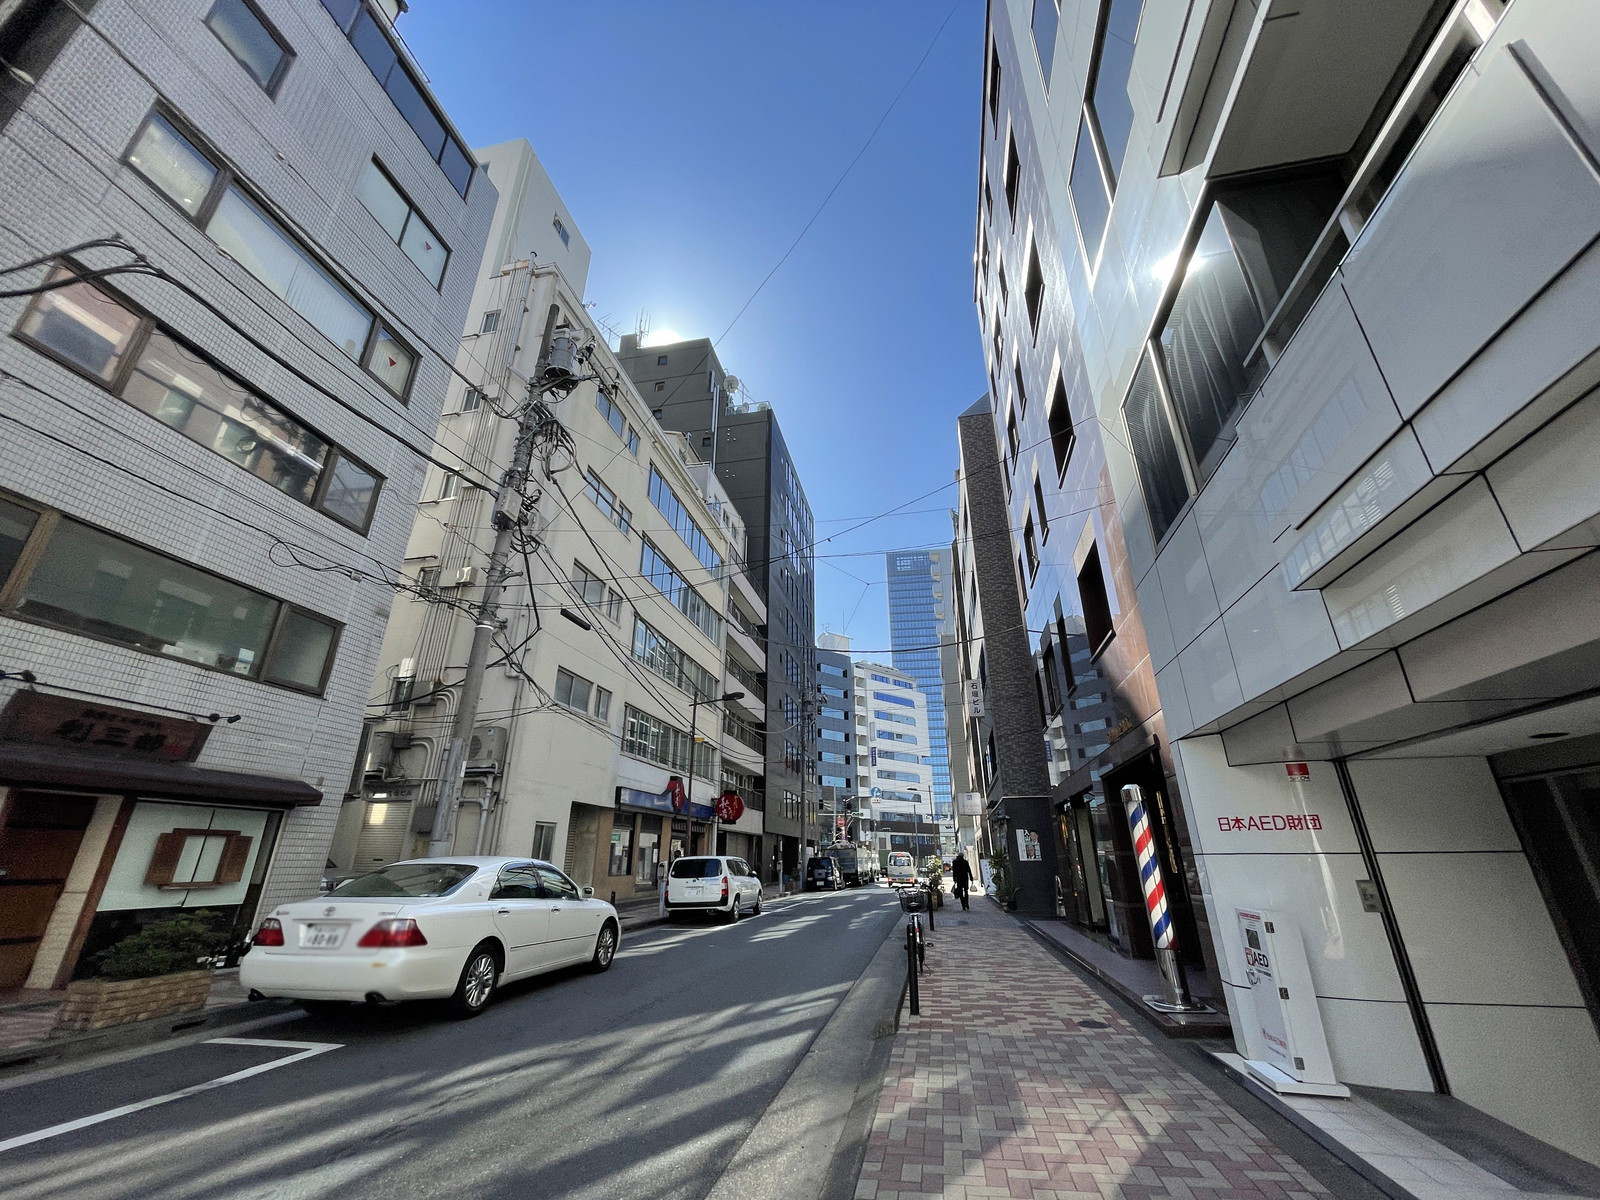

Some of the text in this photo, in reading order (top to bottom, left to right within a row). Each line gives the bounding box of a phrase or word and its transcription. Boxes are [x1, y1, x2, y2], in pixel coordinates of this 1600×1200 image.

[1217, 814, 1323, 832] 日本AED財団
[1252, 951, 1269, 968] AED
